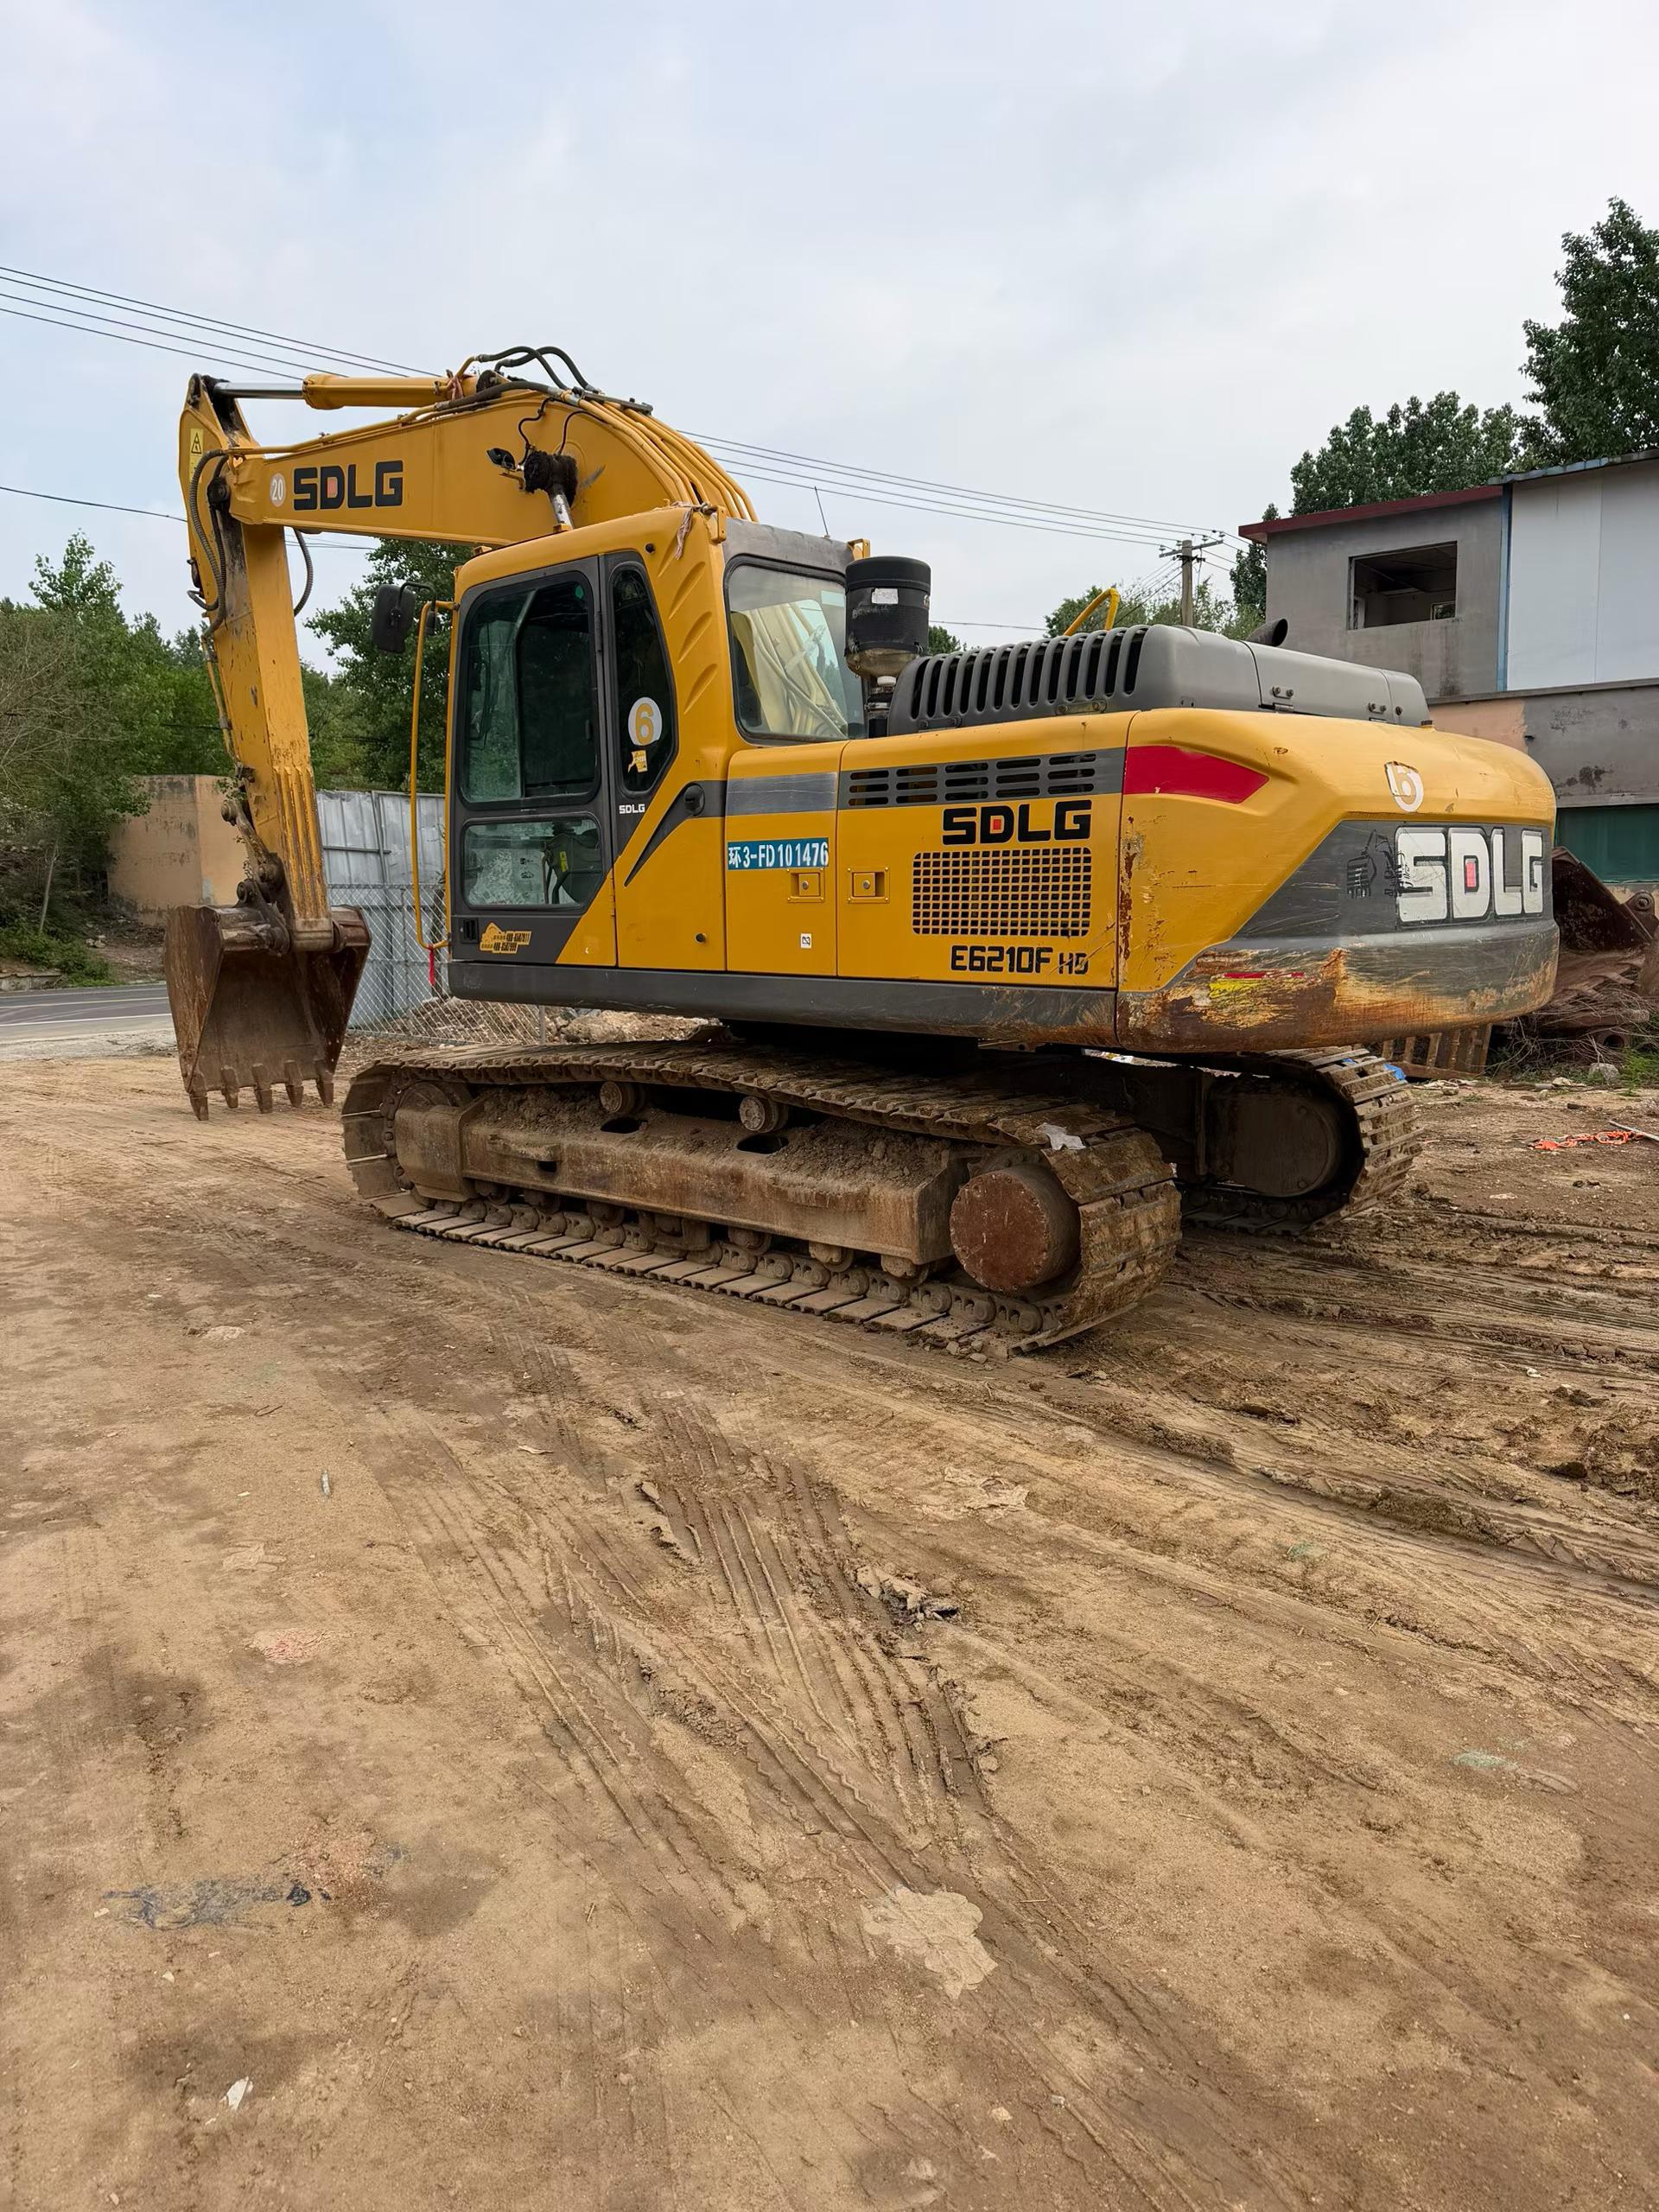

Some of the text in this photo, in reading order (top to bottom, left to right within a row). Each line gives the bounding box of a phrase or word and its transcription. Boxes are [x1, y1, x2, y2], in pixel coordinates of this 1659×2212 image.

[271, 479, 283, 500] 20
[293, 460, 404, 511] SDLG
[635, 702, 654, 746] 6
[619, 804, 645, 814] SDLG
[942, 799, 1092, 845] SDLG
[1395, 826, 1543, 925] SDLG
[951, 945, 1089, 975] E6210F HD
